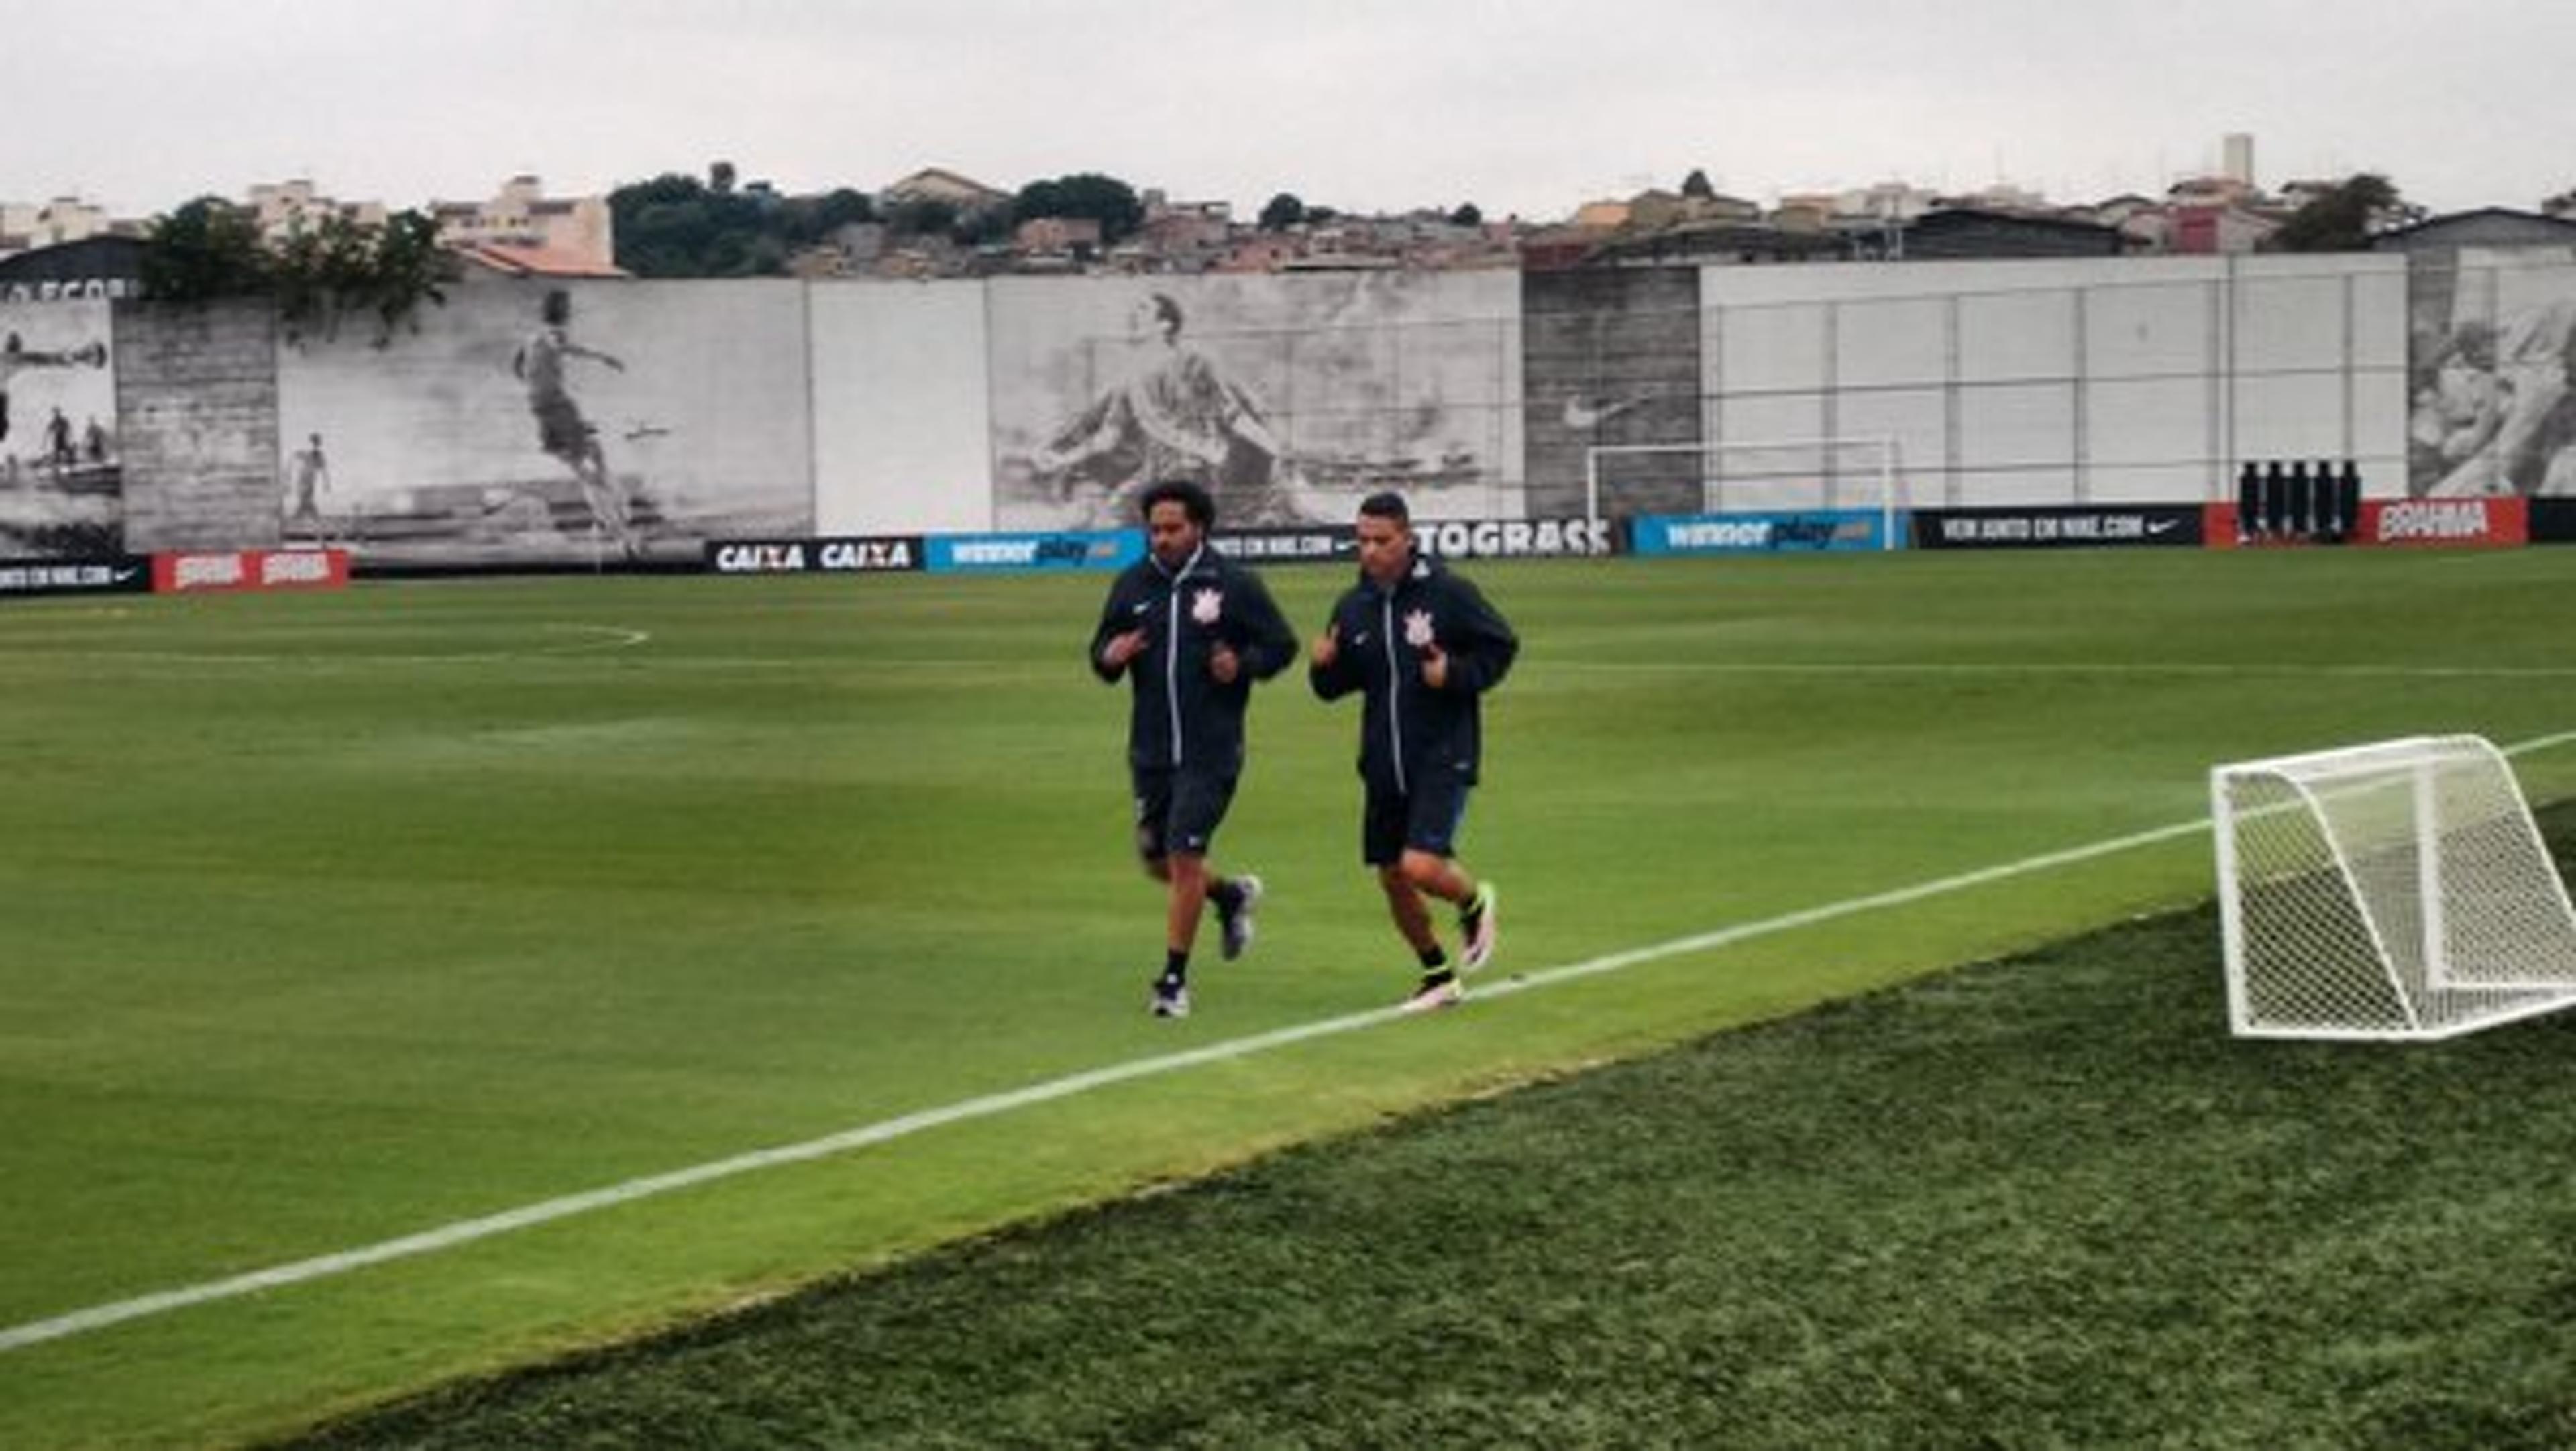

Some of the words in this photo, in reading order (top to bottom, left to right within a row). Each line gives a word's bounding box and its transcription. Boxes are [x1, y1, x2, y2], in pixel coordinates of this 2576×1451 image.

[1409, 519, 1611, 557] TOGRASS
[2378, 501, 2489, 542] BRAHMA
[716, 545, 805, 570] CAIXA
[820, 542, 910, 569] CAIXA
